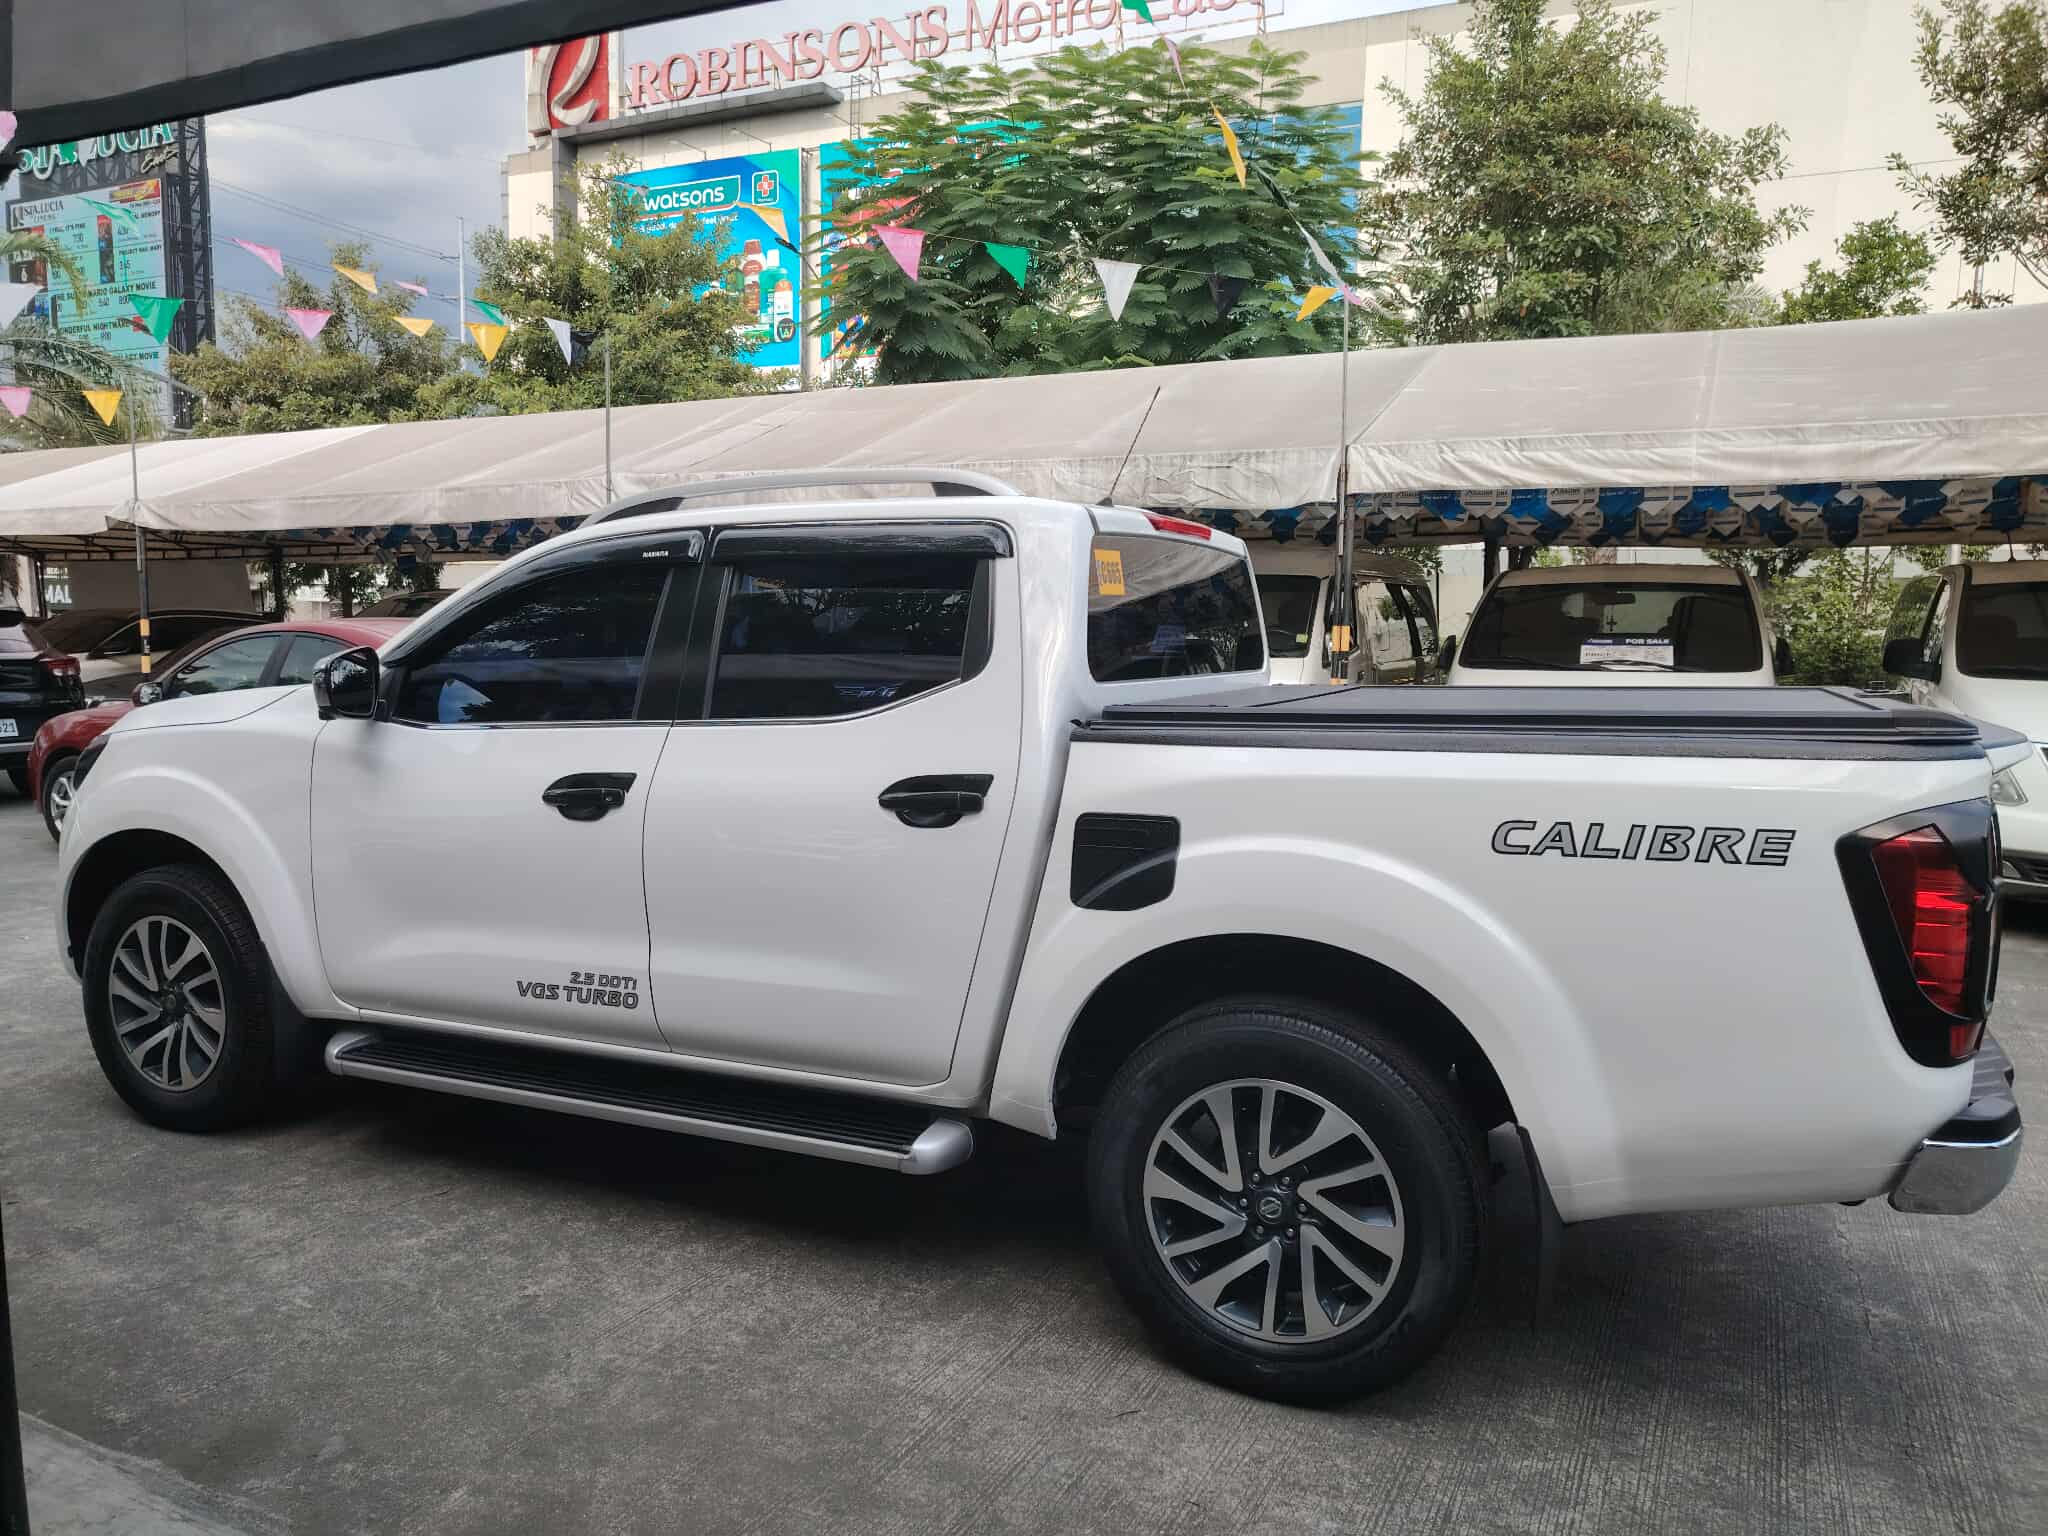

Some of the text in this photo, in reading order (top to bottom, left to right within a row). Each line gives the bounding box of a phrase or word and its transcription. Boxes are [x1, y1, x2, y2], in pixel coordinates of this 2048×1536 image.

[629, 0, 1118, 106] ROBINSONS Metro
[643, 186, 725, 211] watsons
[1491, 820, 1797, 867] CALIBRE
[569, 971, 595, 986] 2.5
[516, 980, 639, 1009] VGS TURBO
